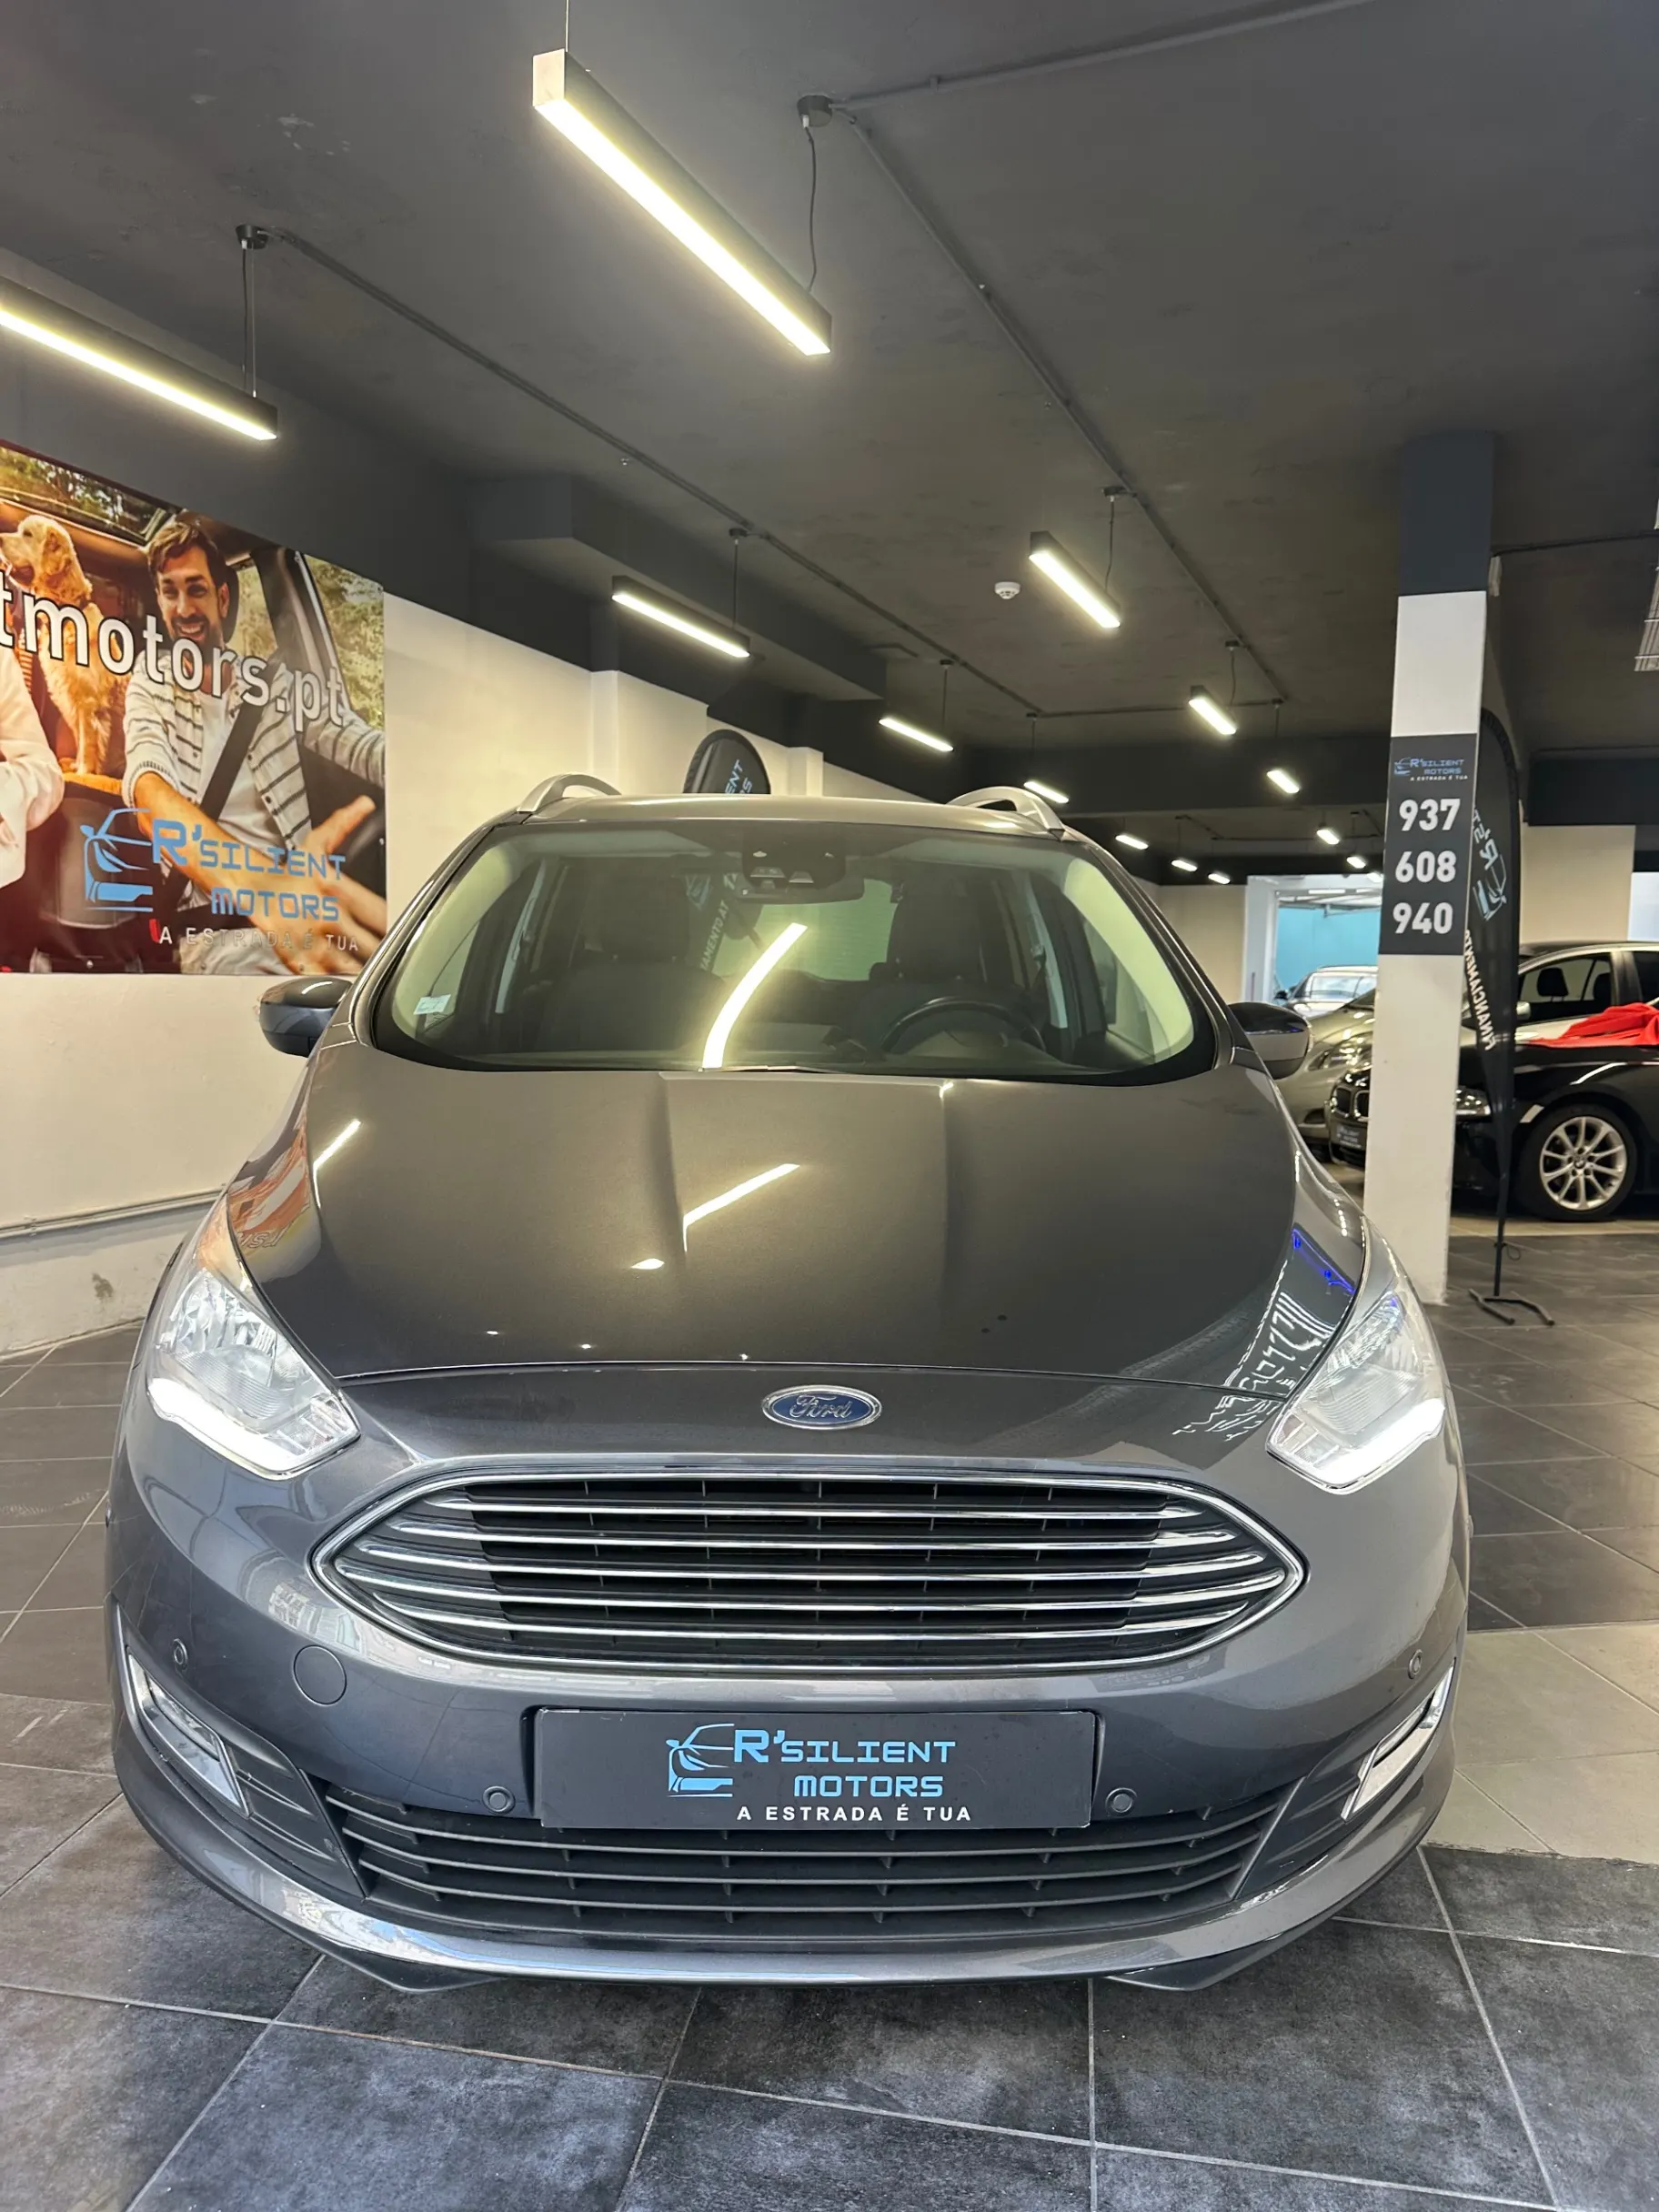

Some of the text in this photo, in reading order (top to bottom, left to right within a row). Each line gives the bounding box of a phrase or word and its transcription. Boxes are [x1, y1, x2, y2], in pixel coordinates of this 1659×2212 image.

[1399, 799, 1461, 831] 937
[153, 819, 347, 880] R'SILIENT
[1395, 850, 1456, 883] 608
[210, 886, 340, 921] MOTORS
[1393, 902, 1453, 934] 940
[159, 926, 173, 944] A
[186, 927, 297, 950] ESTRADA
[326, 933, 359, 951] TUA
[789, 1394, 854, 1419] Ford
[734, 1729, 956, 1763] R'SILIENT
[794, 1775, 944, 1797] MOTORS
[737, 1803, 971, 1822] A ESTRADA É TUA
